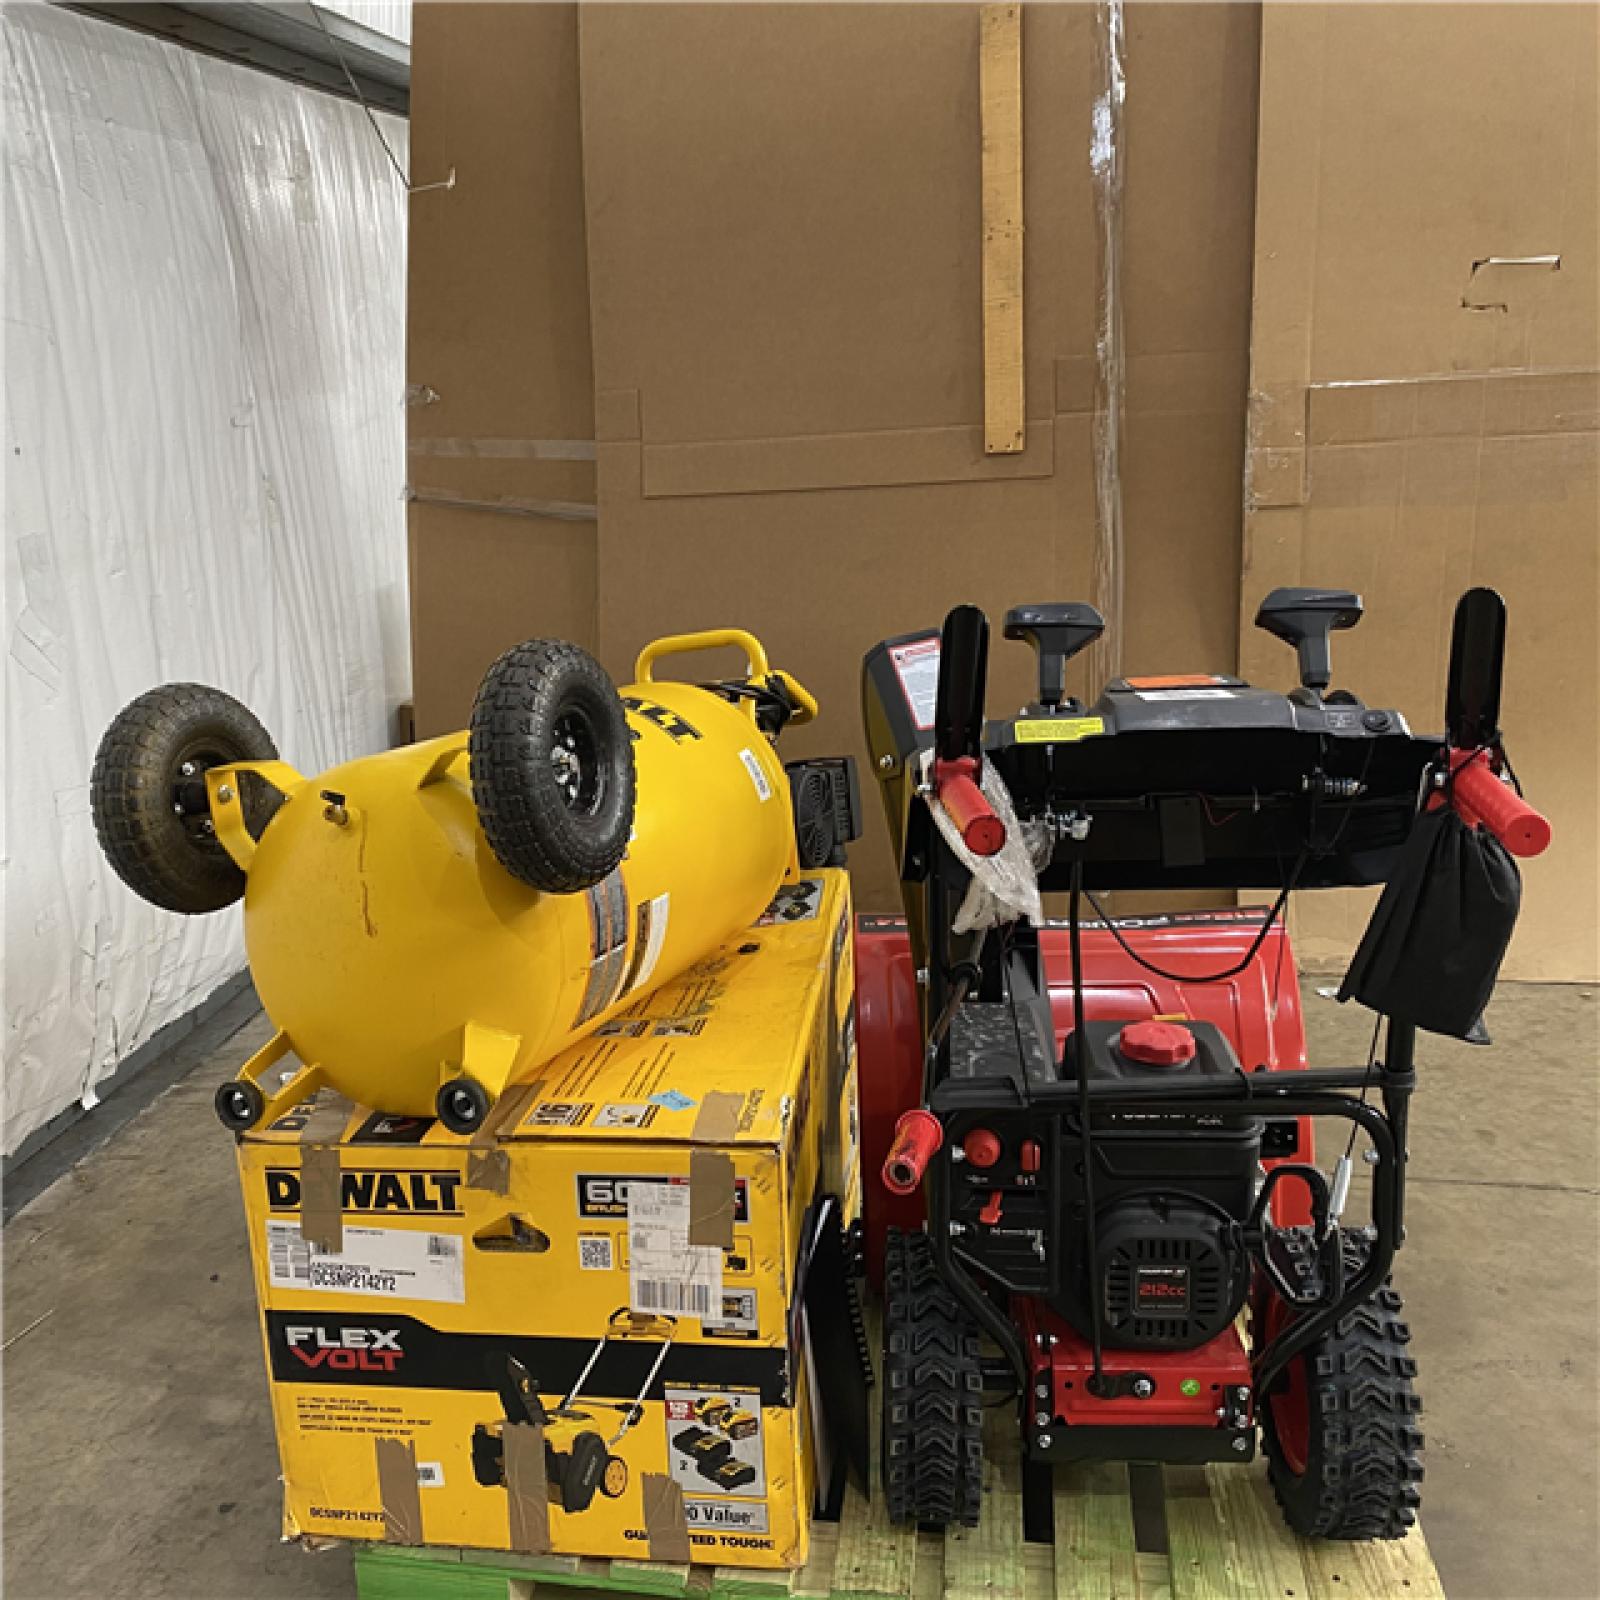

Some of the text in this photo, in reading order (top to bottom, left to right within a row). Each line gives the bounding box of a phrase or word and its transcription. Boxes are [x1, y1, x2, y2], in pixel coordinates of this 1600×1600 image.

[267, 1172, 461, 1211] DWALT
[286, 1326, 402, 1350] FLEX
[289, 1347, 406, 1371] VOLT
